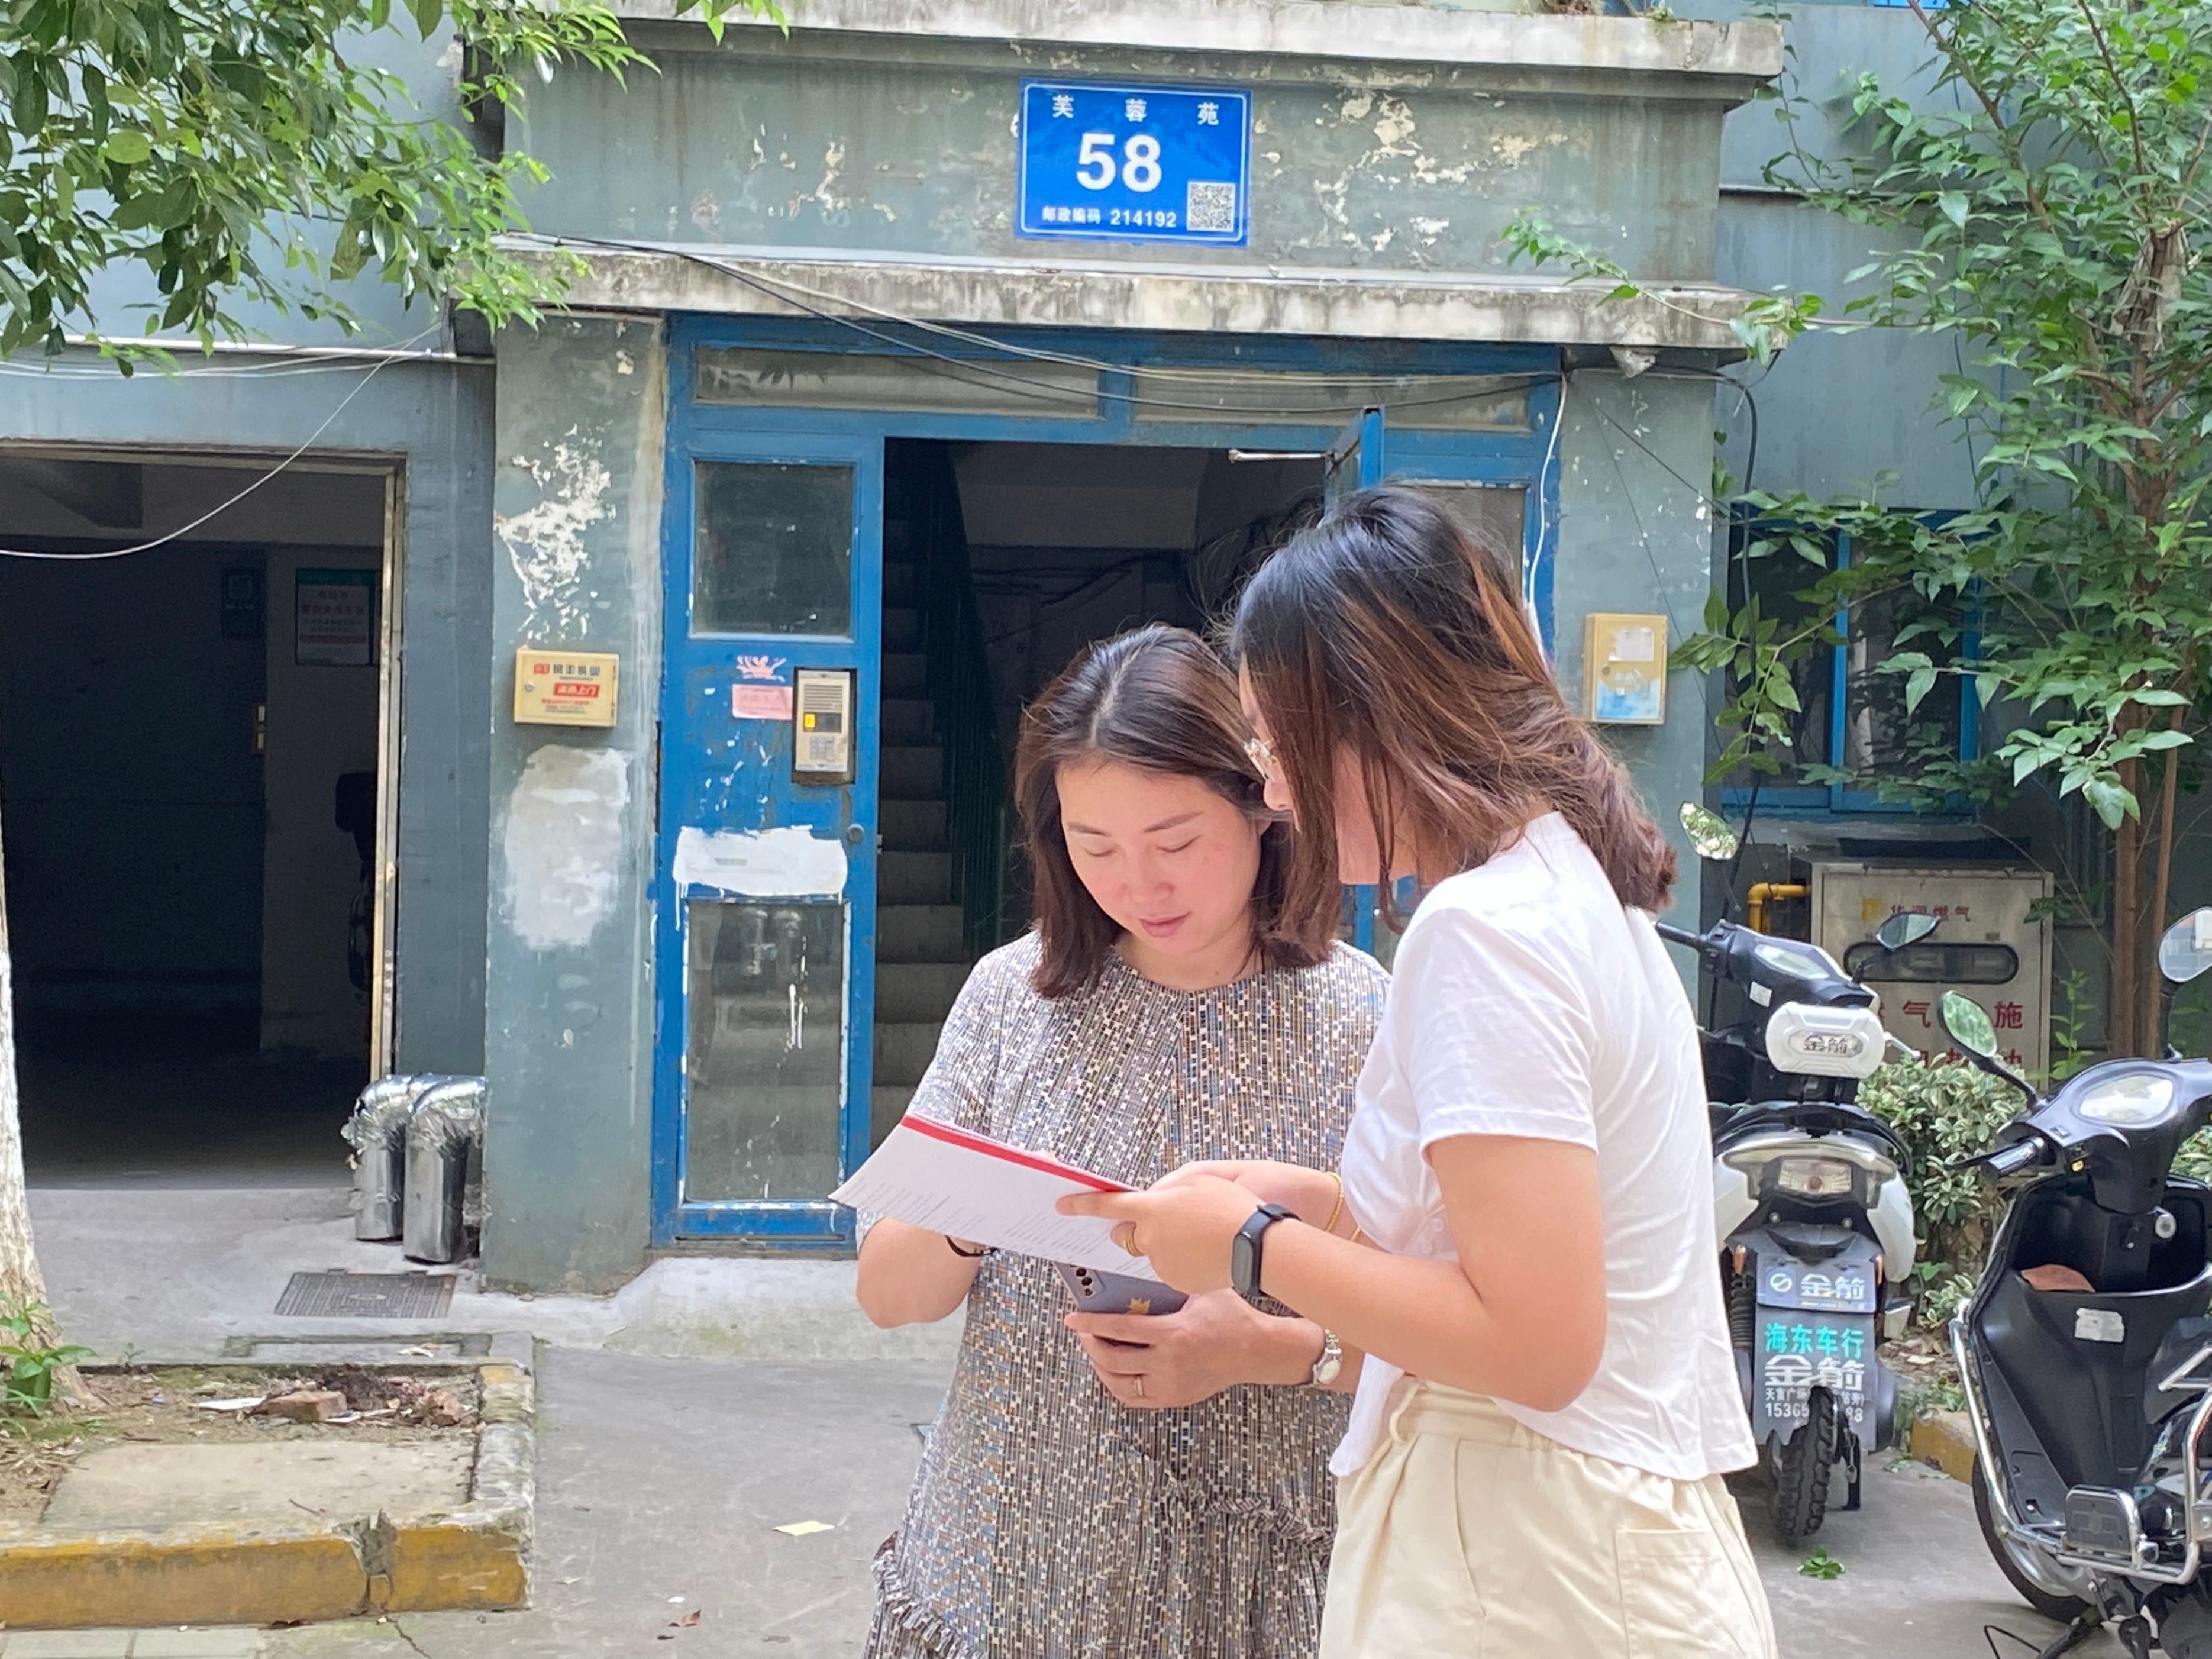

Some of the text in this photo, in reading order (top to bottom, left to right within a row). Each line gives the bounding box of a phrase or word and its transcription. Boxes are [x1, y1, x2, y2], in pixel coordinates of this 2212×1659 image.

[1052, 94, 1220, 126] 芙蓉苑
[1076, 132, 1163, 193] 58
[1042, 205, 1177, 228] 邮政编码 214192
[1765, 1322, 1864, 1359] 海东车行
